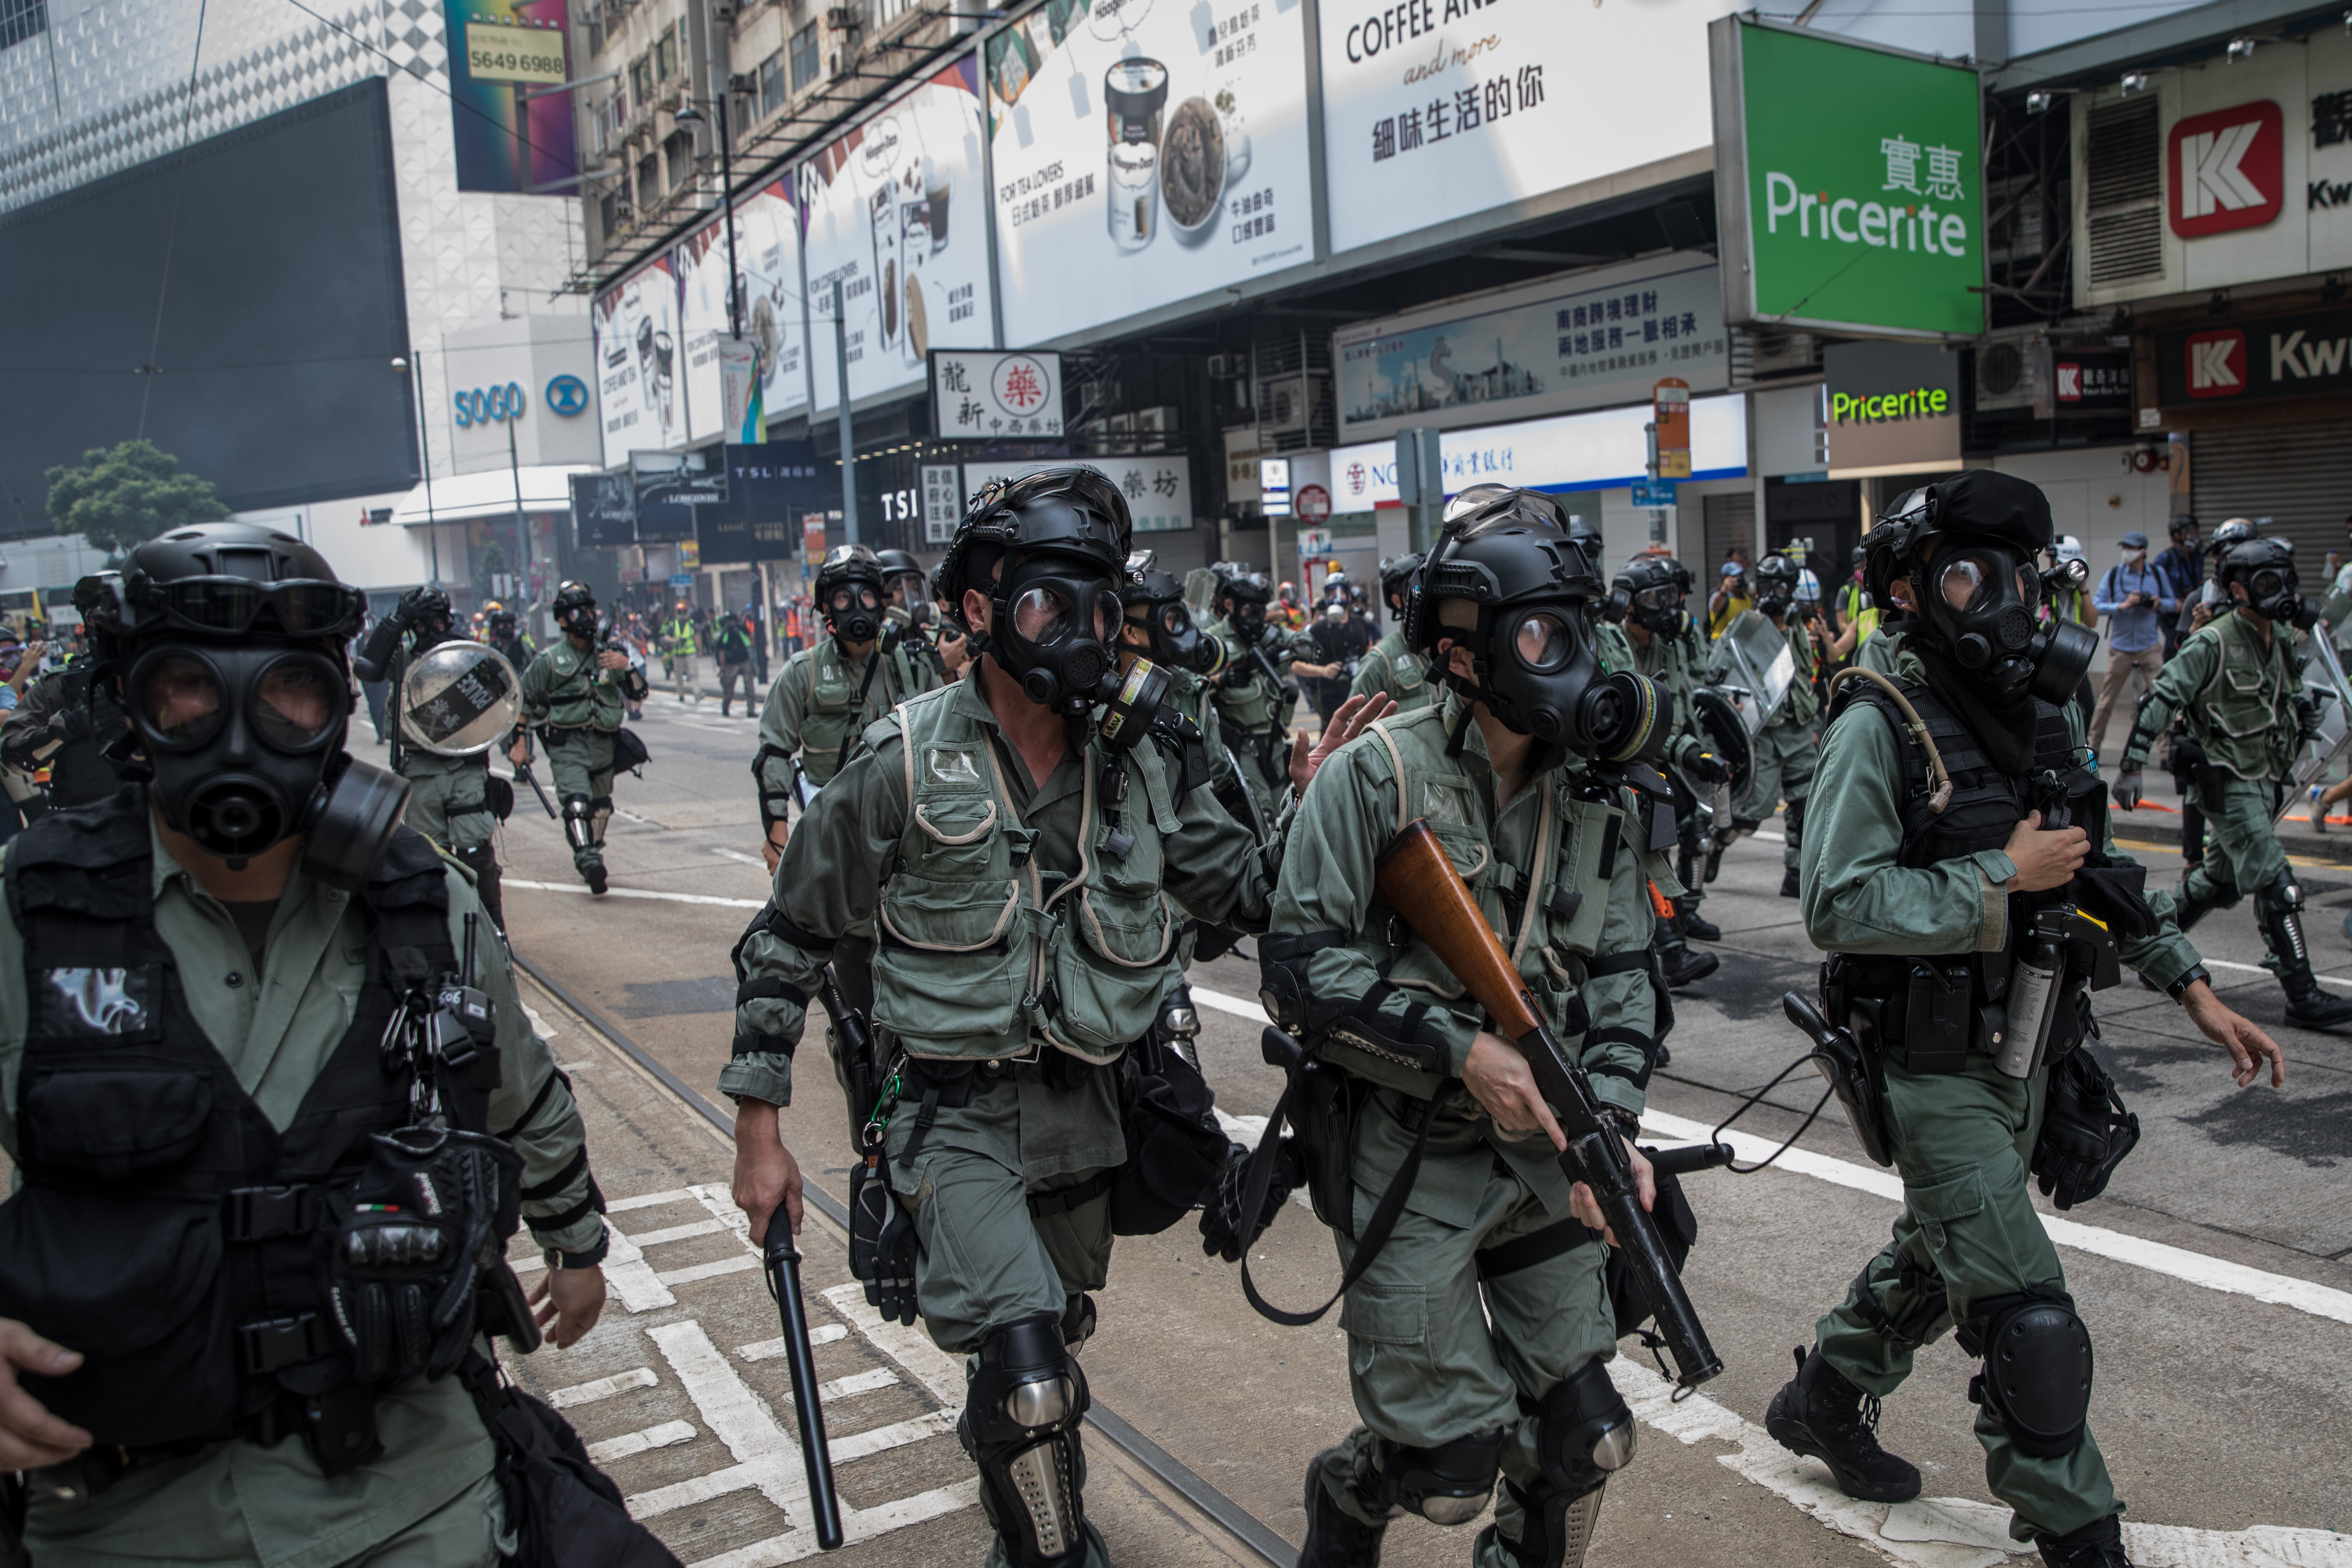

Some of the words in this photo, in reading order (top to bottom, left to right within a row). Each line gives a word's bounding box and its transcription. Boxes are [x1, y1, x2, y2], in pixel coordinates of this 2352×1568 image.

[1347, 0, 1434, 63] COFFEE
[1451, 33, 1502, 67] more
[471, 50, 516, 70] 5649
[520, 54, 564, 74] 6988
[1372, 65, 1544, 163] 細味生活的你
[1000, 181, 1016, 205] FOR
[1017, 175, 1032, 196] TEA
[1032, 159, 1064, 190] LOVERS
[1881, 134, 1966, 201] 實惠
[1766, 172, 1967, 257] Pricerite
[1556, 290, 1658, 332] 南商跨境理財
[1558, 312, 1697, 358] 兩地服務一脈相承
[2270, 329, 2352, 381] Kw
[455, 380, 522, 427] SOGO
[1004, 365, 1042, 407] 藥
[1833, 387, 1947, 421] Pricerite
[989, 416, 1063, 435] 中西藥坊
[735, 467, 772, 479] TSL
[456, 673, 494, 710] POLICE
